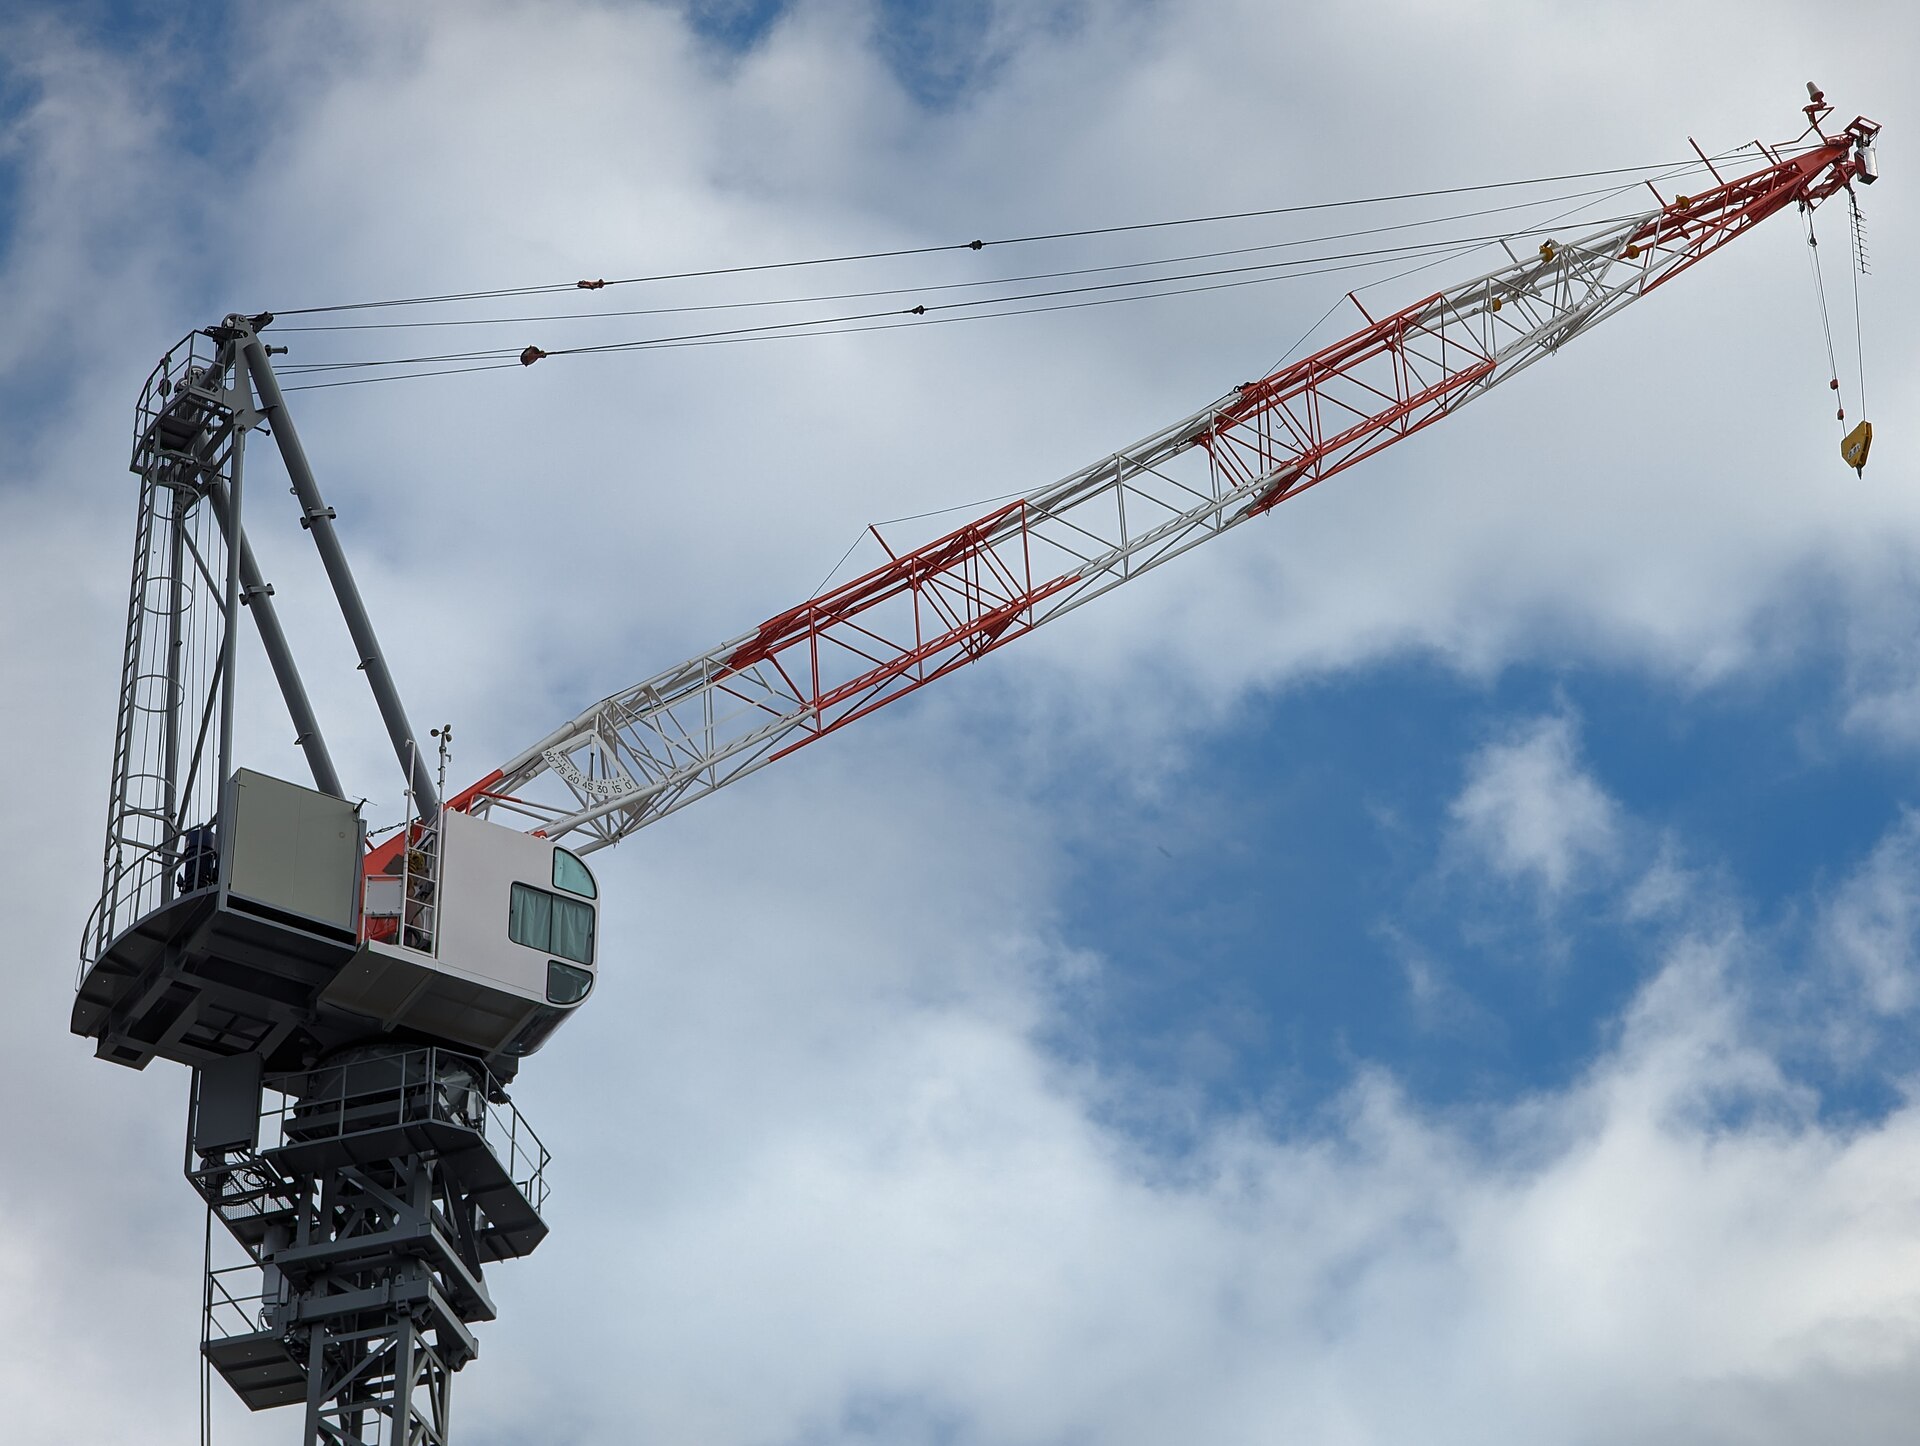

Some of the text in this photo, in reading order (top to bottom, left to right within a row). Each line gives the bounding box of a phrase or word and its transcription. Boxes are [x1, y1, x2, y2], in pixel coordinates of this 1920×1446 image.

[544, 750, 632, 794] 90 75 60 45 30 15 0
